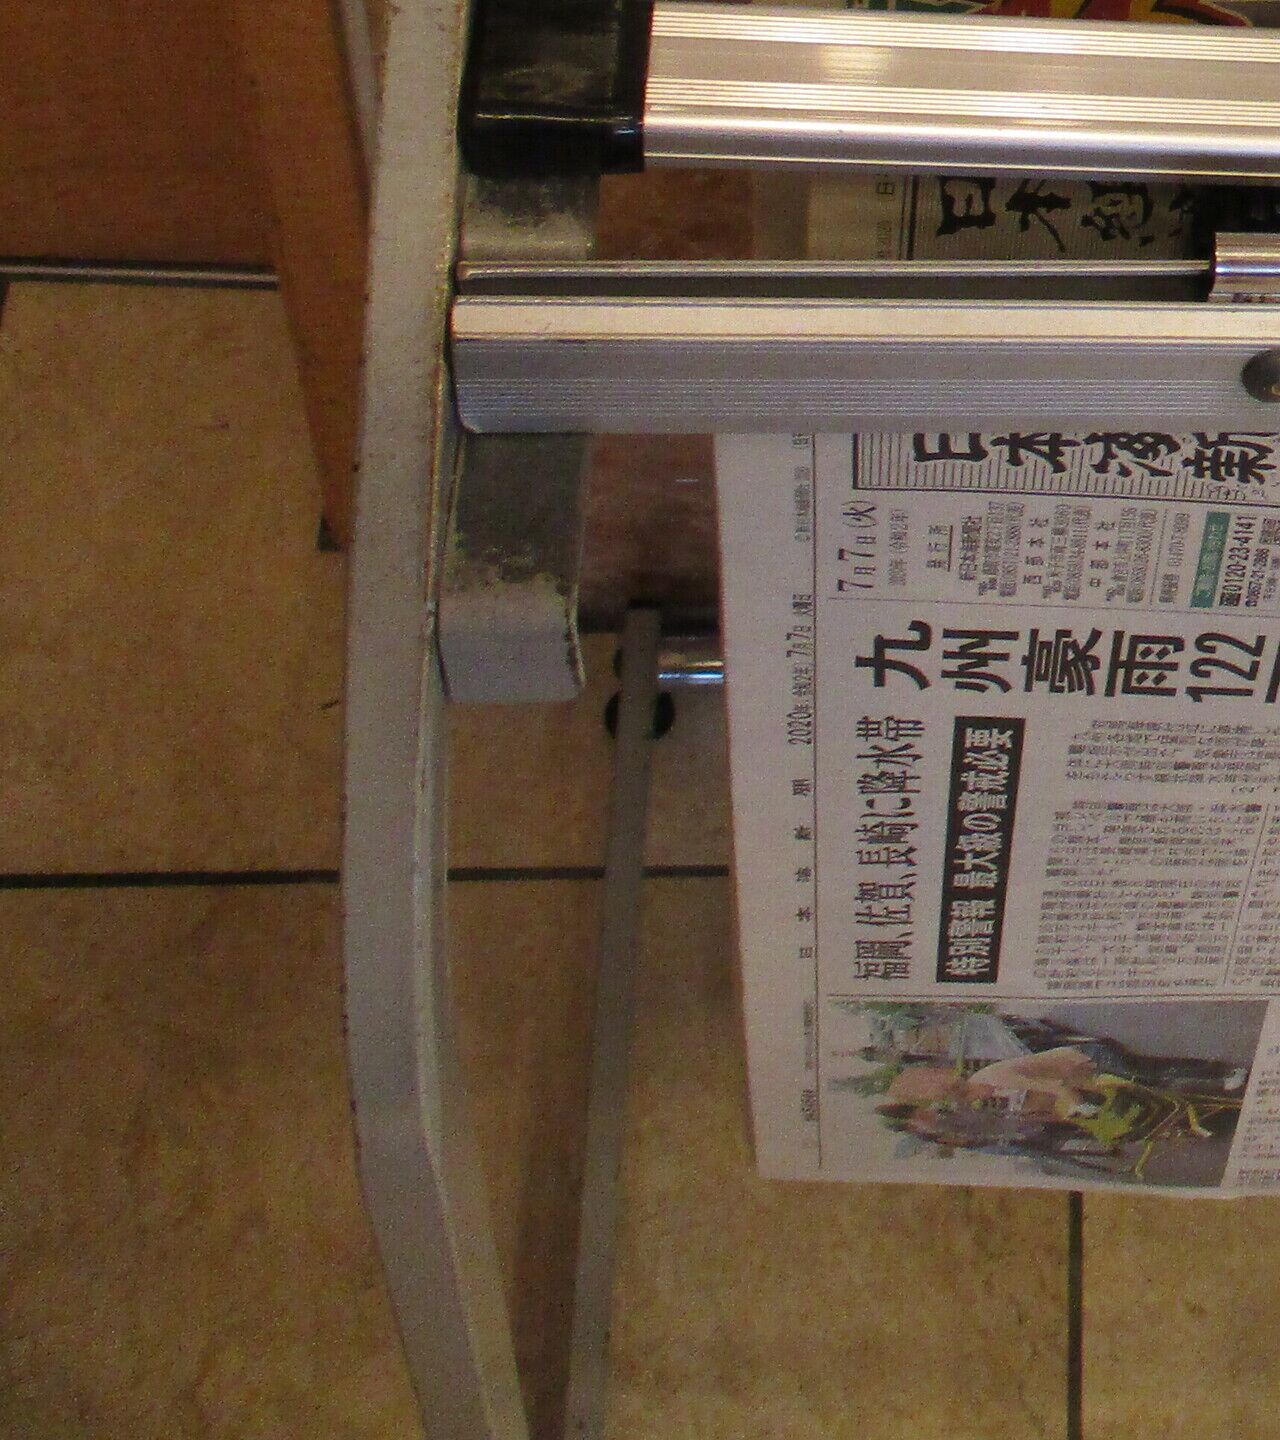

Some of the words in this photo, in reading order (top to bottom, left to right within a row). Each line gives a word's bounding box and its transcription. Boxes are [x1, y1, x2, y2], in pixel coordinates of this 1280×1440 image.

[837, 499, 878, 593] 7月7日(火)
[1222, 516, 1257, 592] 0120-23-4141
[852, 713, 926, 982] 福岡、佐賀、長崎に降水帯
[952, 725, 1015, 891] 最大級の警戒必要
[944, 897, 998, 976] 特別警報
